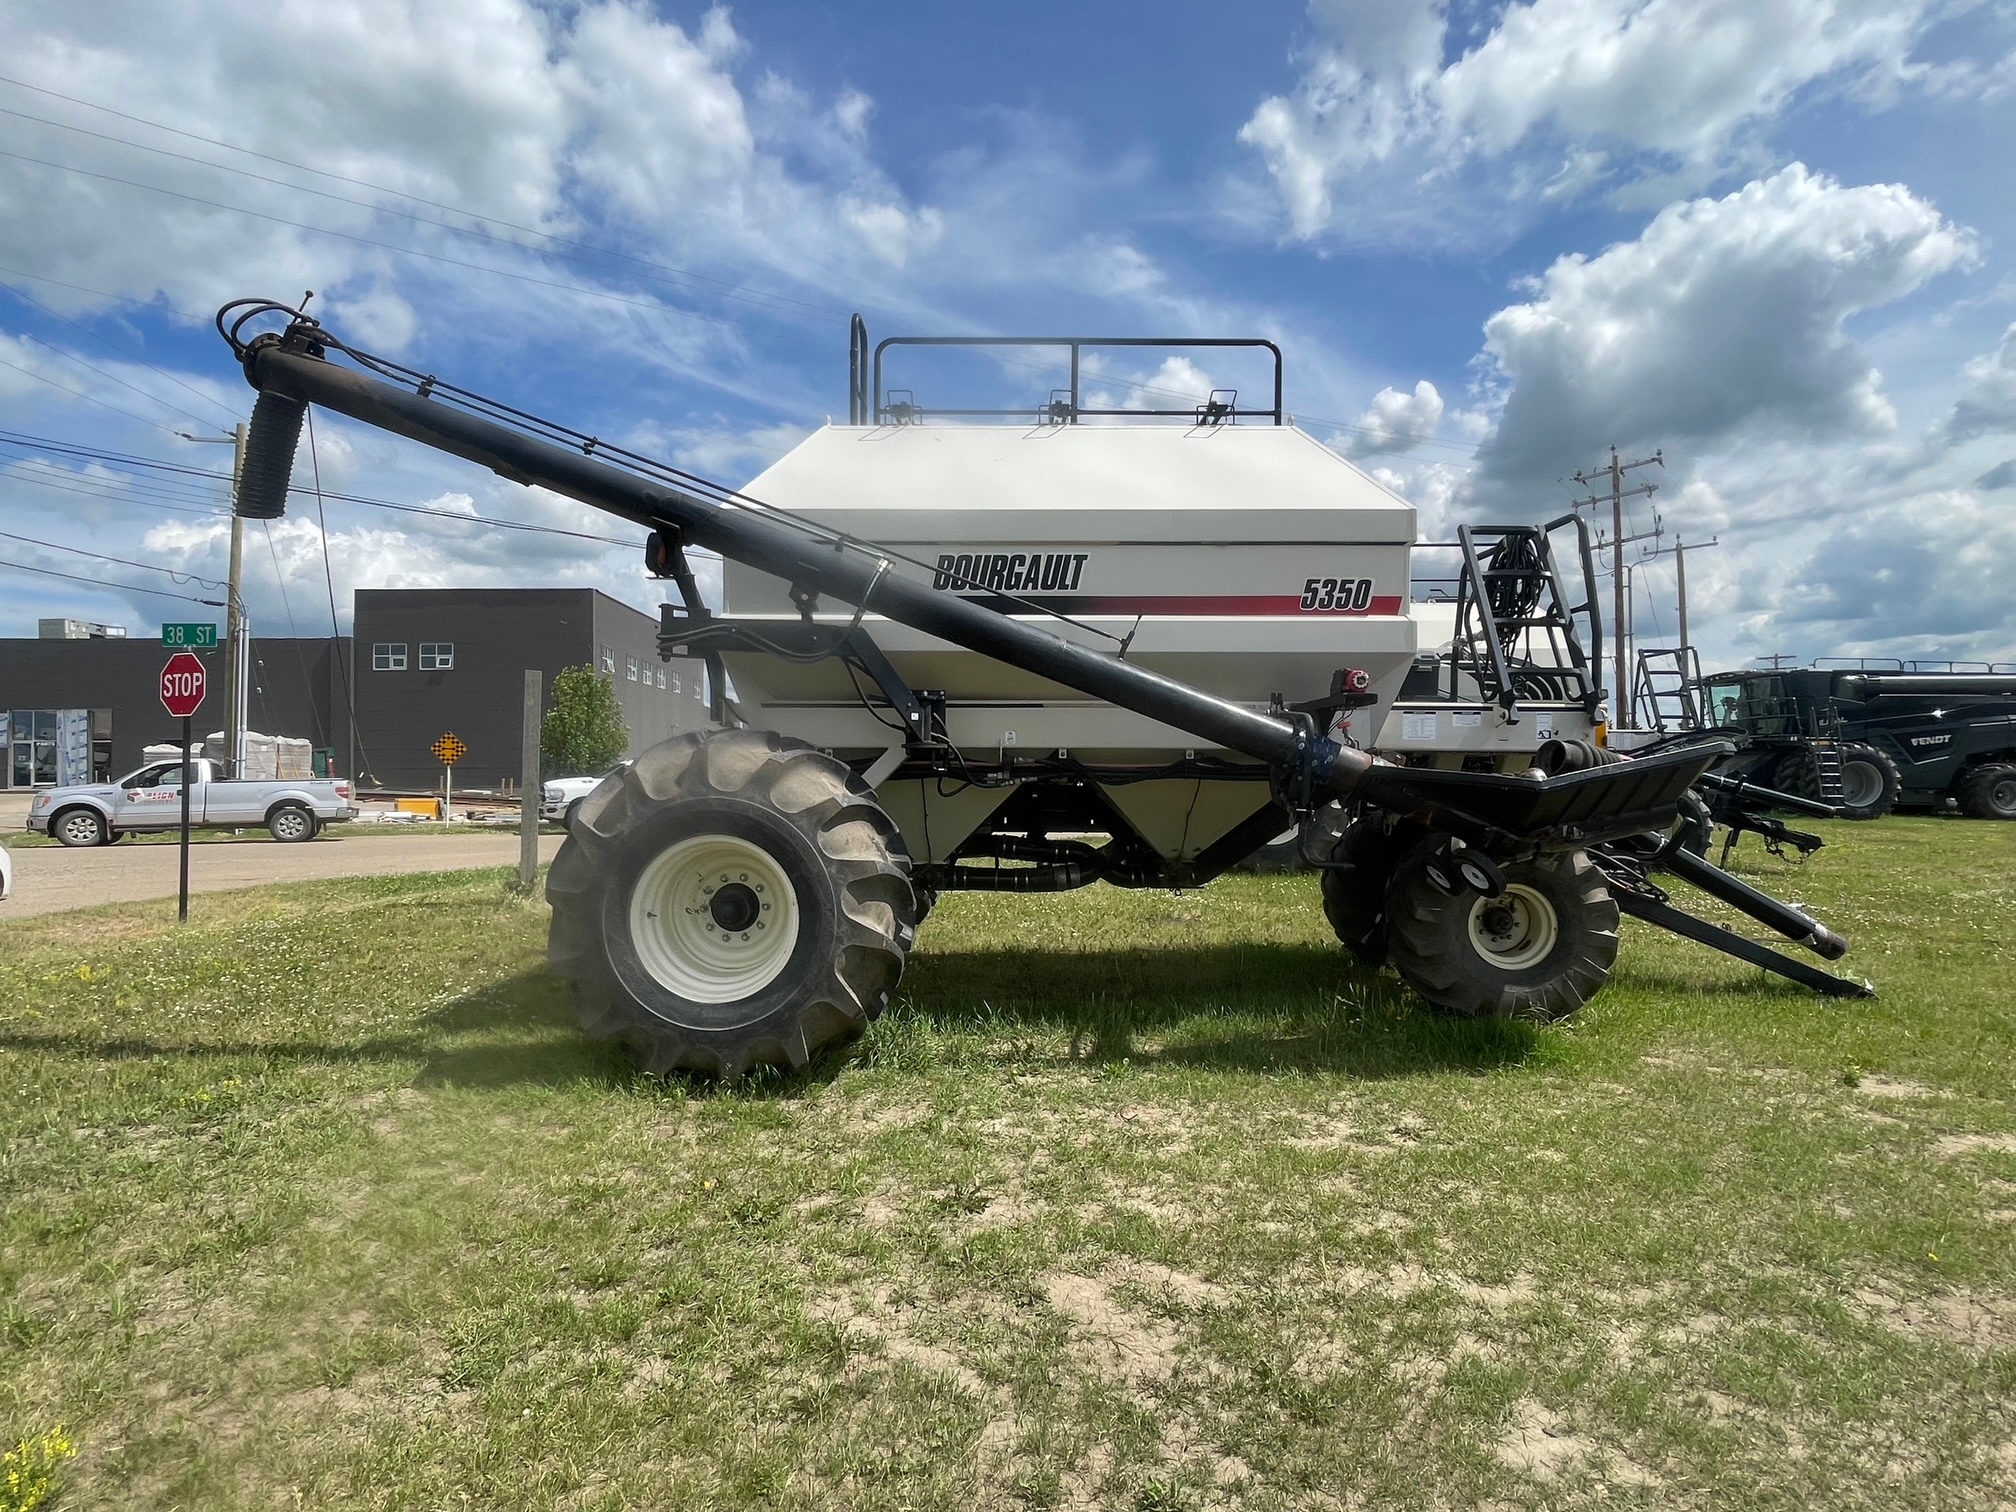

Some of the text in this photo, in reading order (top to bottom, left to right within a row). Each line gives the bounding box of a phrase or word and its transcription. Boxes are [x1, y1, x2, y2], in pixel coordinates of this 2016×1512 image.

[932, 553, 1089, 591] BOURGAULT
[1300, 578, 1372, 610] 5350
[166, 626, 212, 644] 38 ST
[163, 672, 203, 698] STOP
[1910, 734, 1952, 747] FENDT
[146, 791, 175, 800] ALIGN
